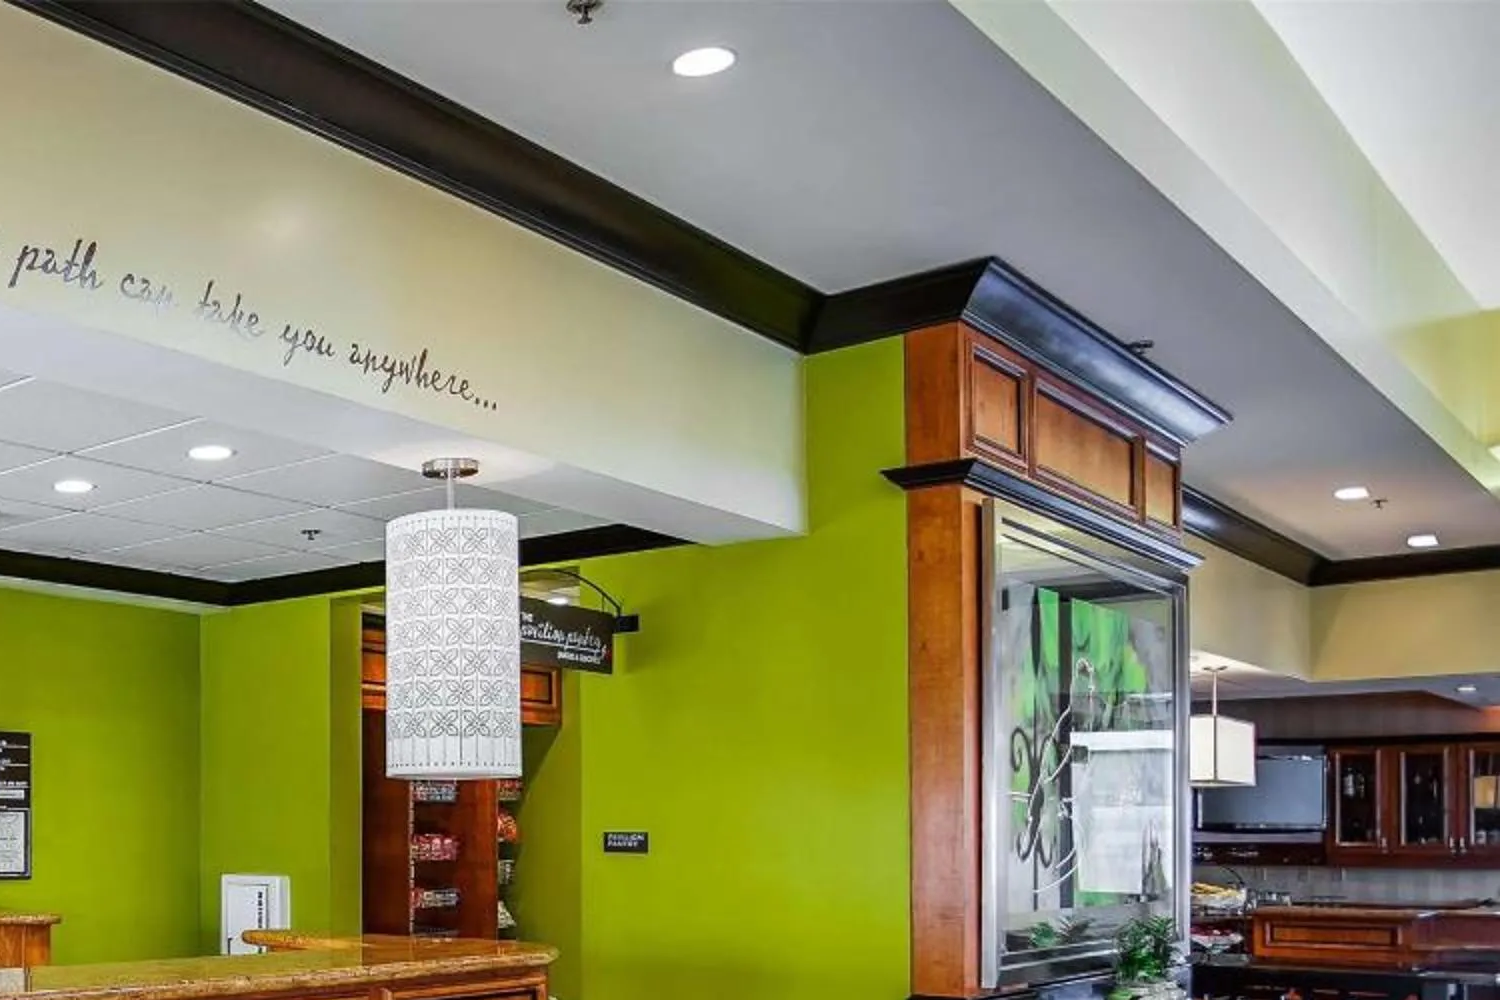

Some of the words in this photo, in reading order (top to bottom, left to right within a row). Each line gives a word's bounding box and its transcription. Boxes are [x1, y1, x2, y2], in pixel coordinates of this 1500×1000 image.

[7, 238, 103, 289] path
[119, 272, 179, 310] can
[197, 279, 265, 338] take
[279, 321, 337, 367] you
[348, 347, 498, 412] anywhere...
